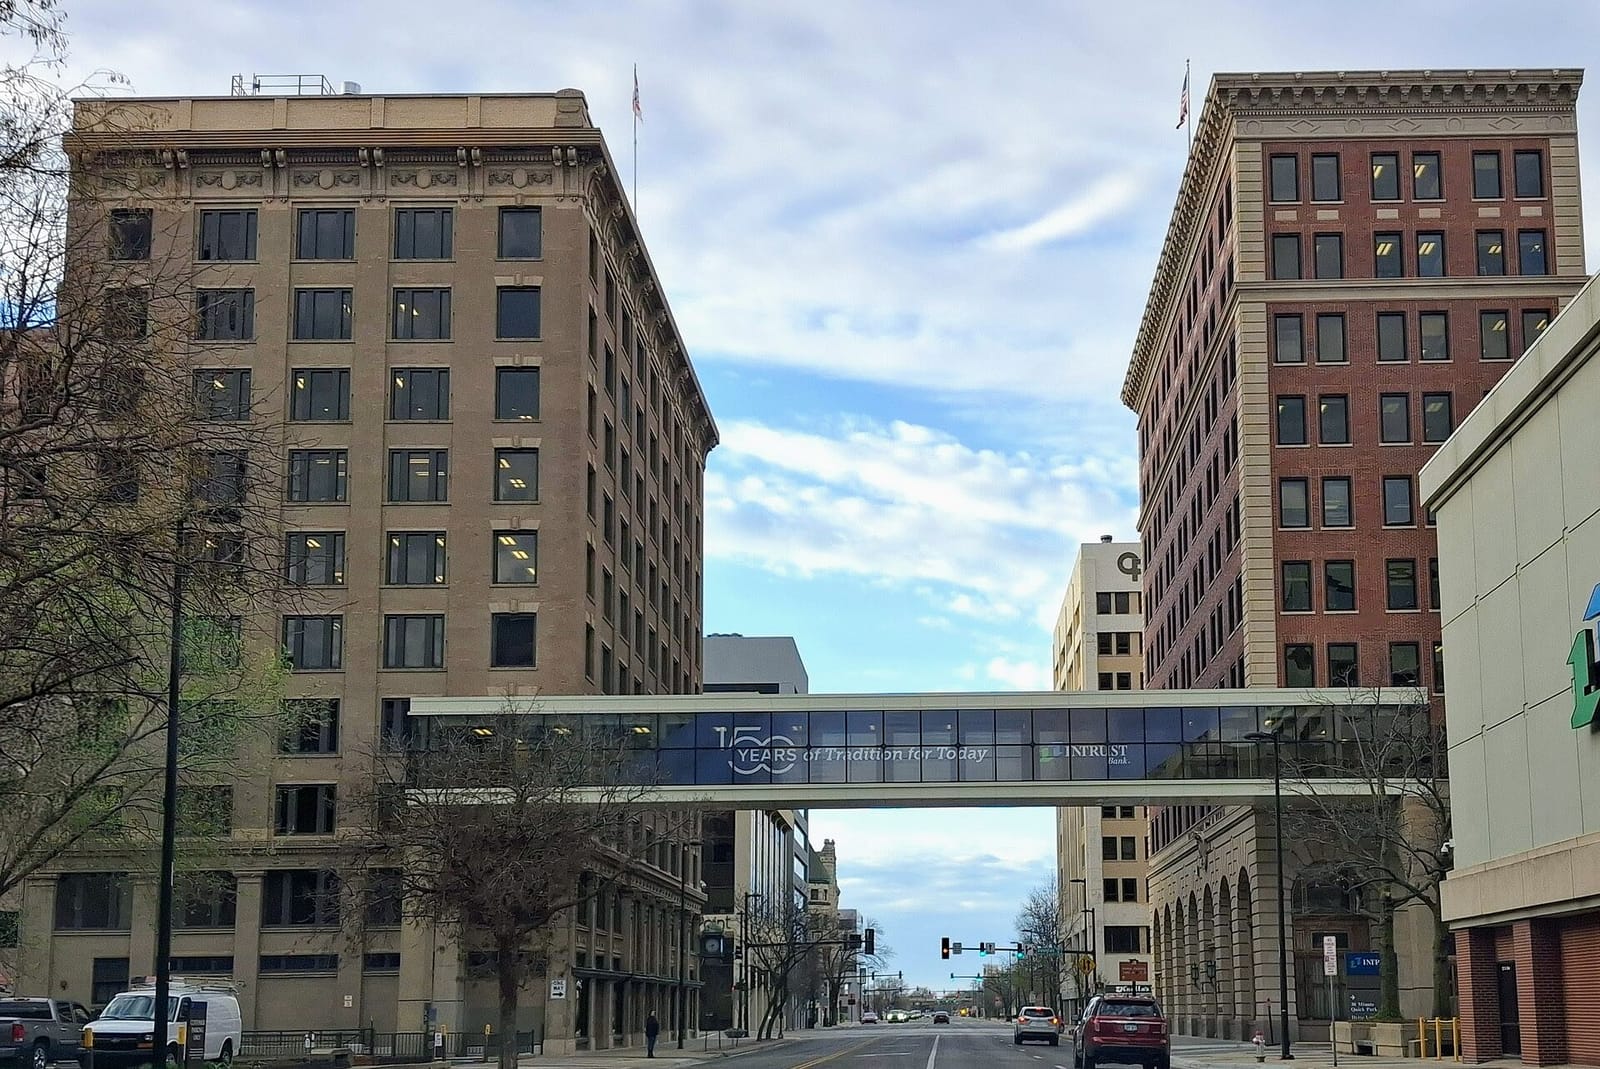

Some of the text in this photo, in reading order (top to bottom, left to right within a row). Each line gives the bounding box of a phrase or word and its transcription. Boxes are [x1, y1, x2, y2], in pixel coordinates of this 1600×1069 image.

[713, 726, 795, 775] 150
[737, 747, 988, 763] YEARS of Tradition for Today
[1065, 744, 1128, 757] INTRUST
